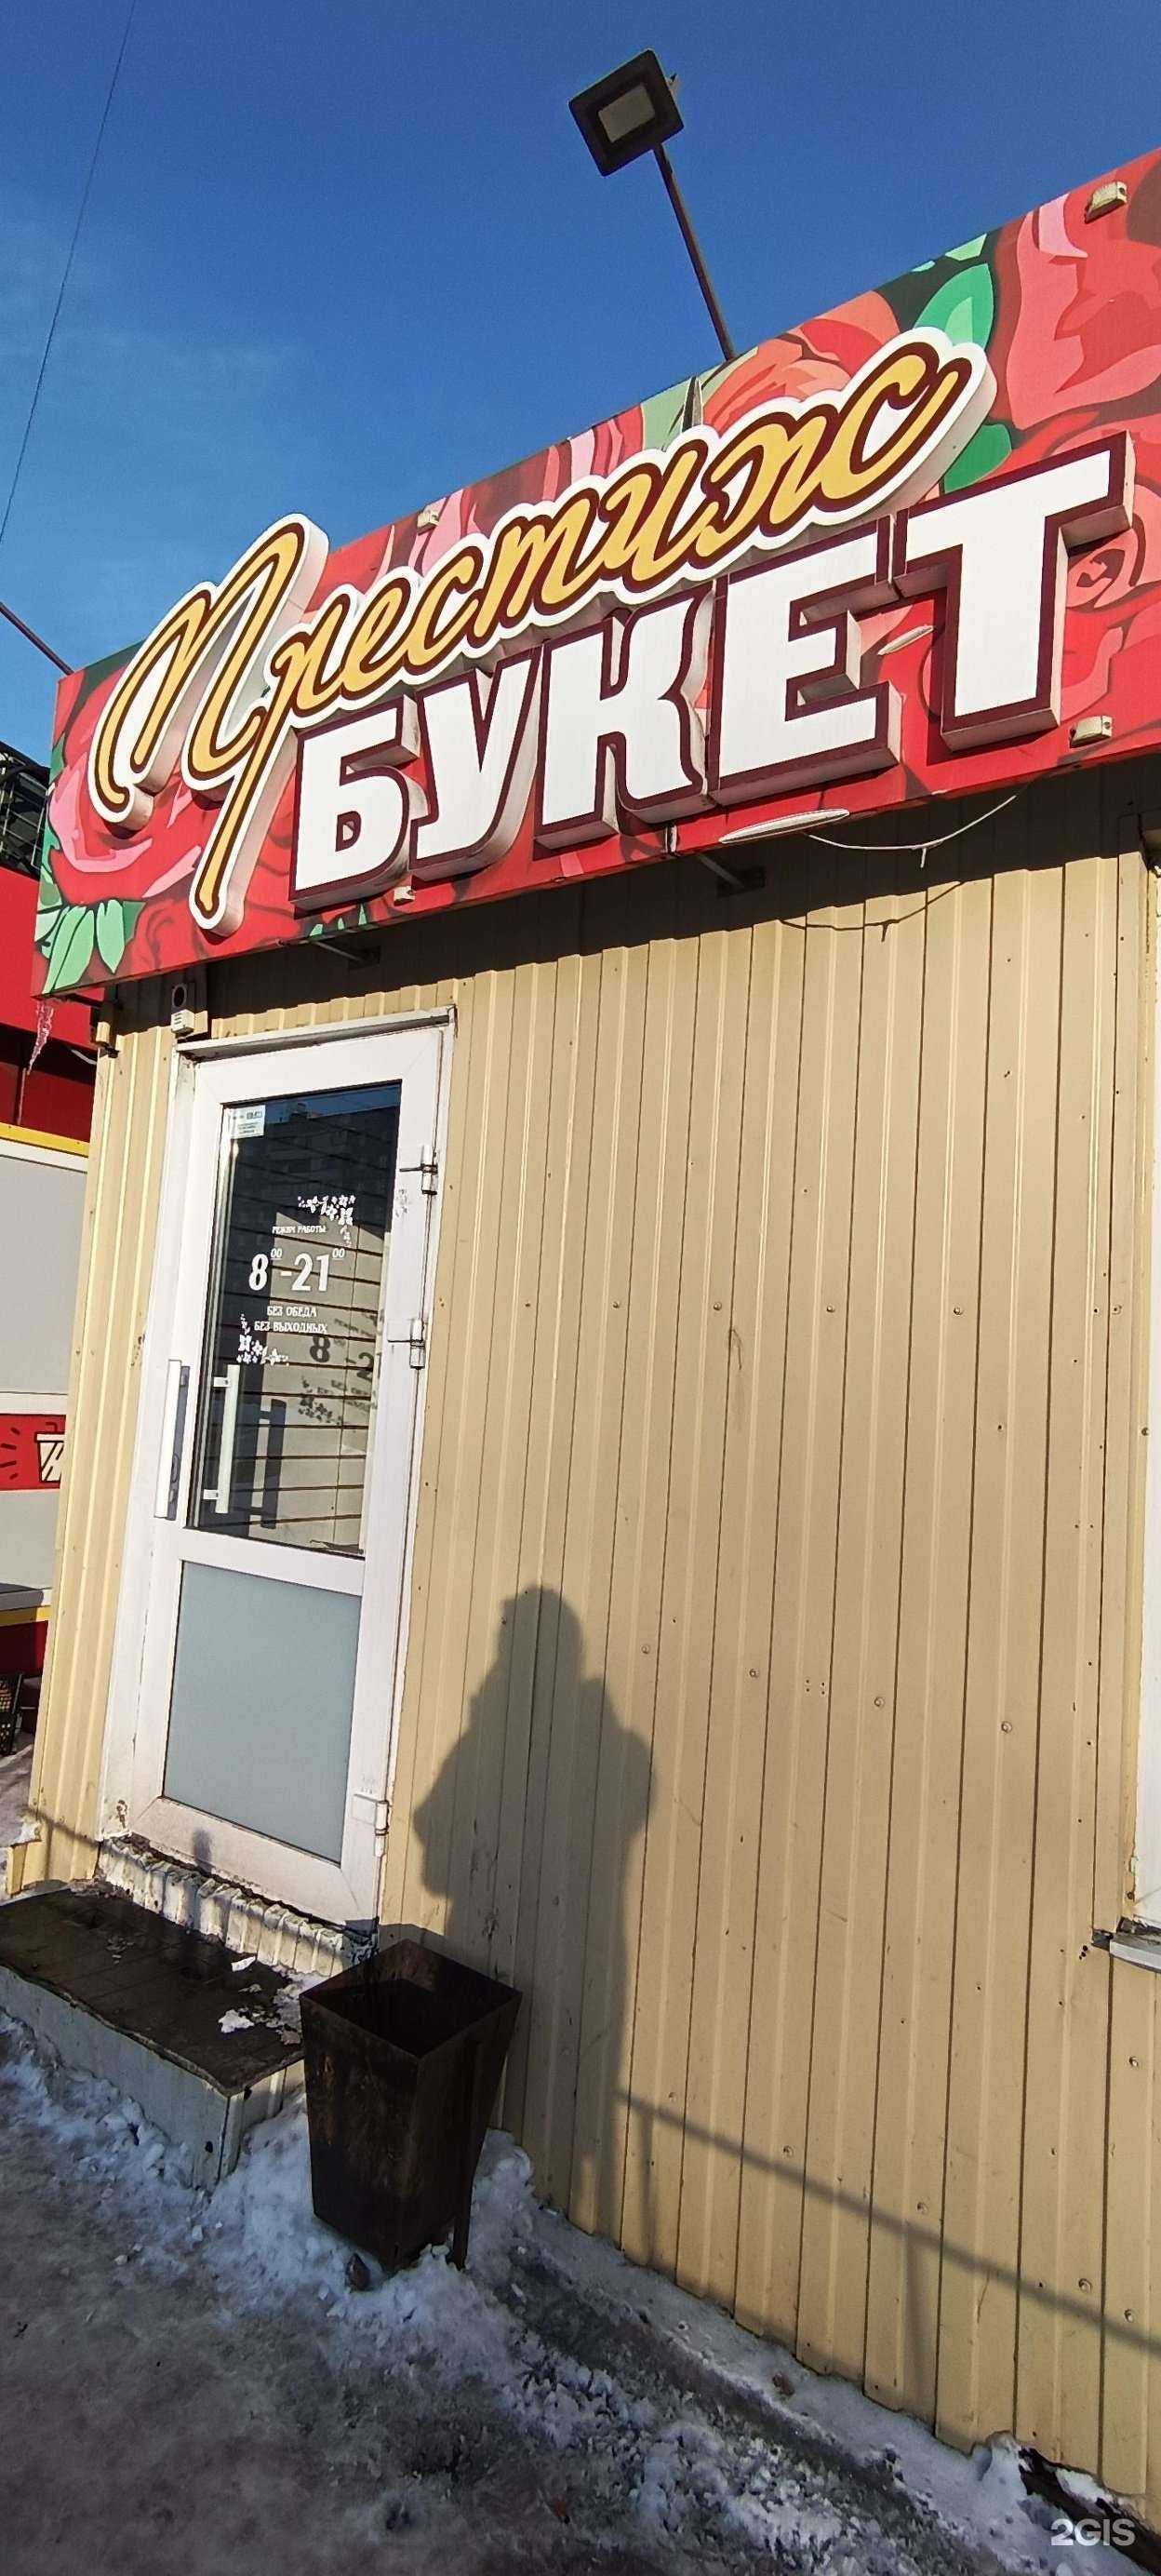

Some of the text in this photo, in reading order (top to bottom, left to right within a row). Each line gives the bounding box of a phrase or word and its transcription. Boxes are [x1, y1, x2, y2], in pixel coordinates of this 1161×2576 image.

[90, 330, 992, 927] Престиж
[290, 432, 1128, 909] БУКЕТ
[297, 1225, 327, 1234] РАБОТЫ
[266, 1305, 317, 1318] БЕЗ ОБЕДА
[254, 1321, 271, 1332] БЕЗ
[273, 1322, 328, 1335] ВЫХОДНЫХ
